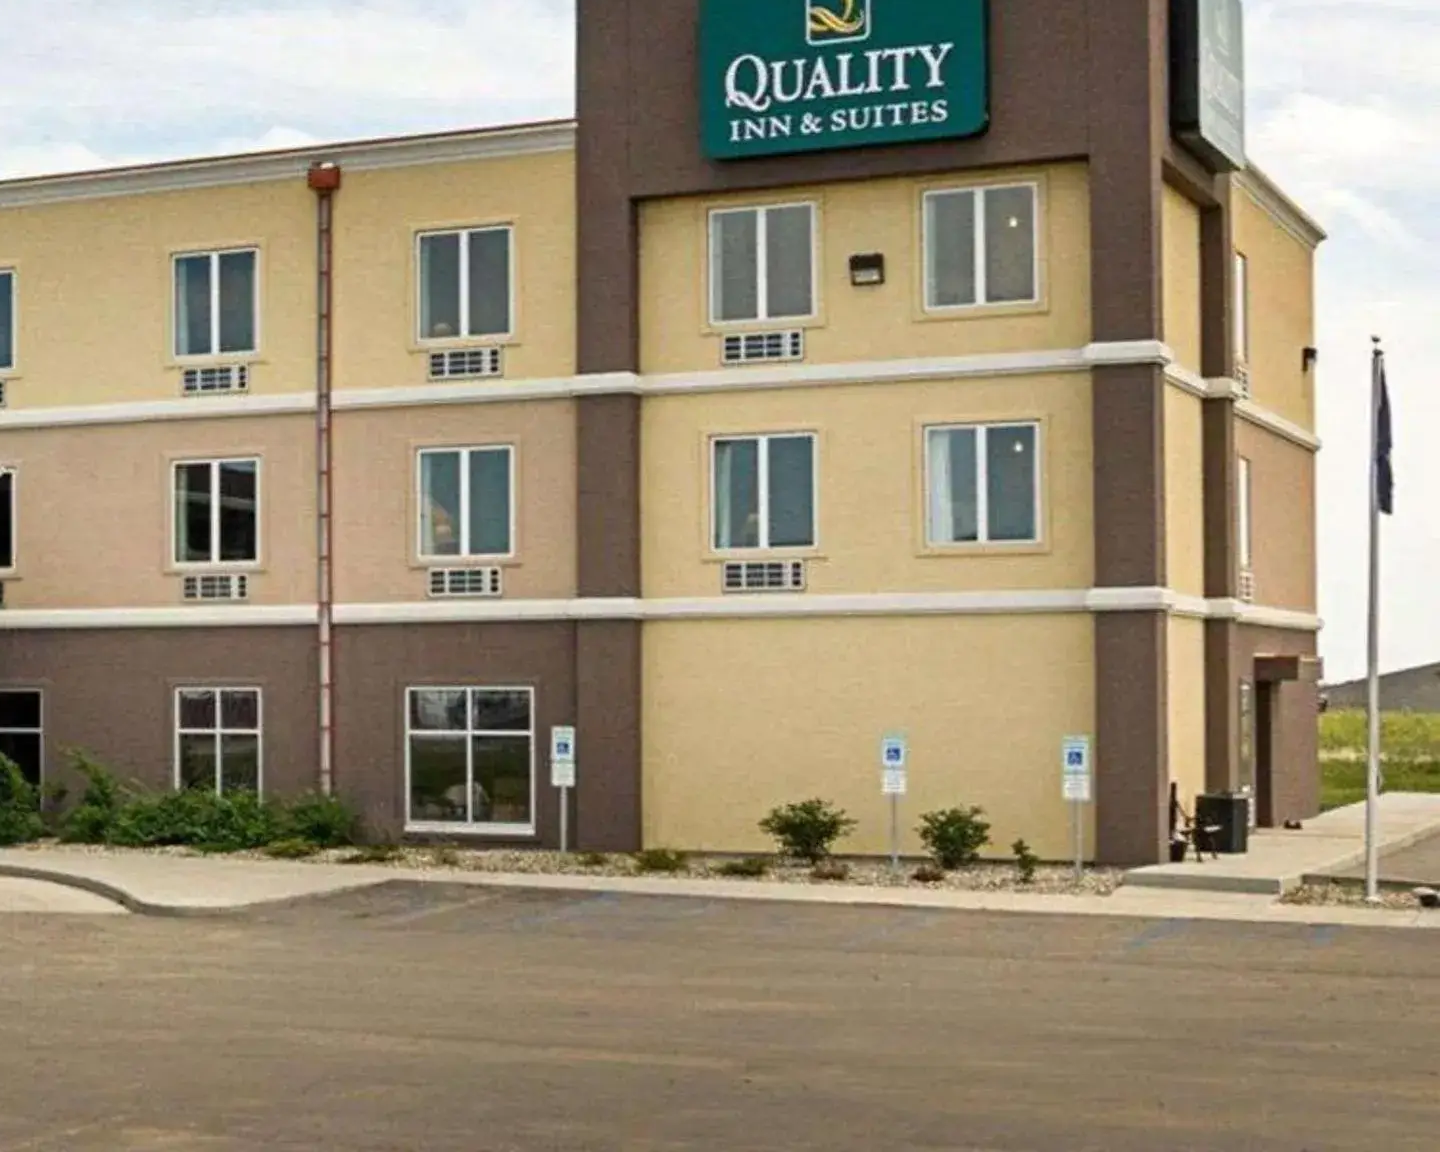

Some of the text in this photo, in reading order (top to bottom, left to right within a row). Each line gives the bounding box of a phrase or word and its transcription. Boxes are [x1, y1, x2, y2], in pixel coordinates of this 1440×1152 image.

[725, 43, 954, 112] QUALITY
[729, 99, 948, 142] INN & SUITES
